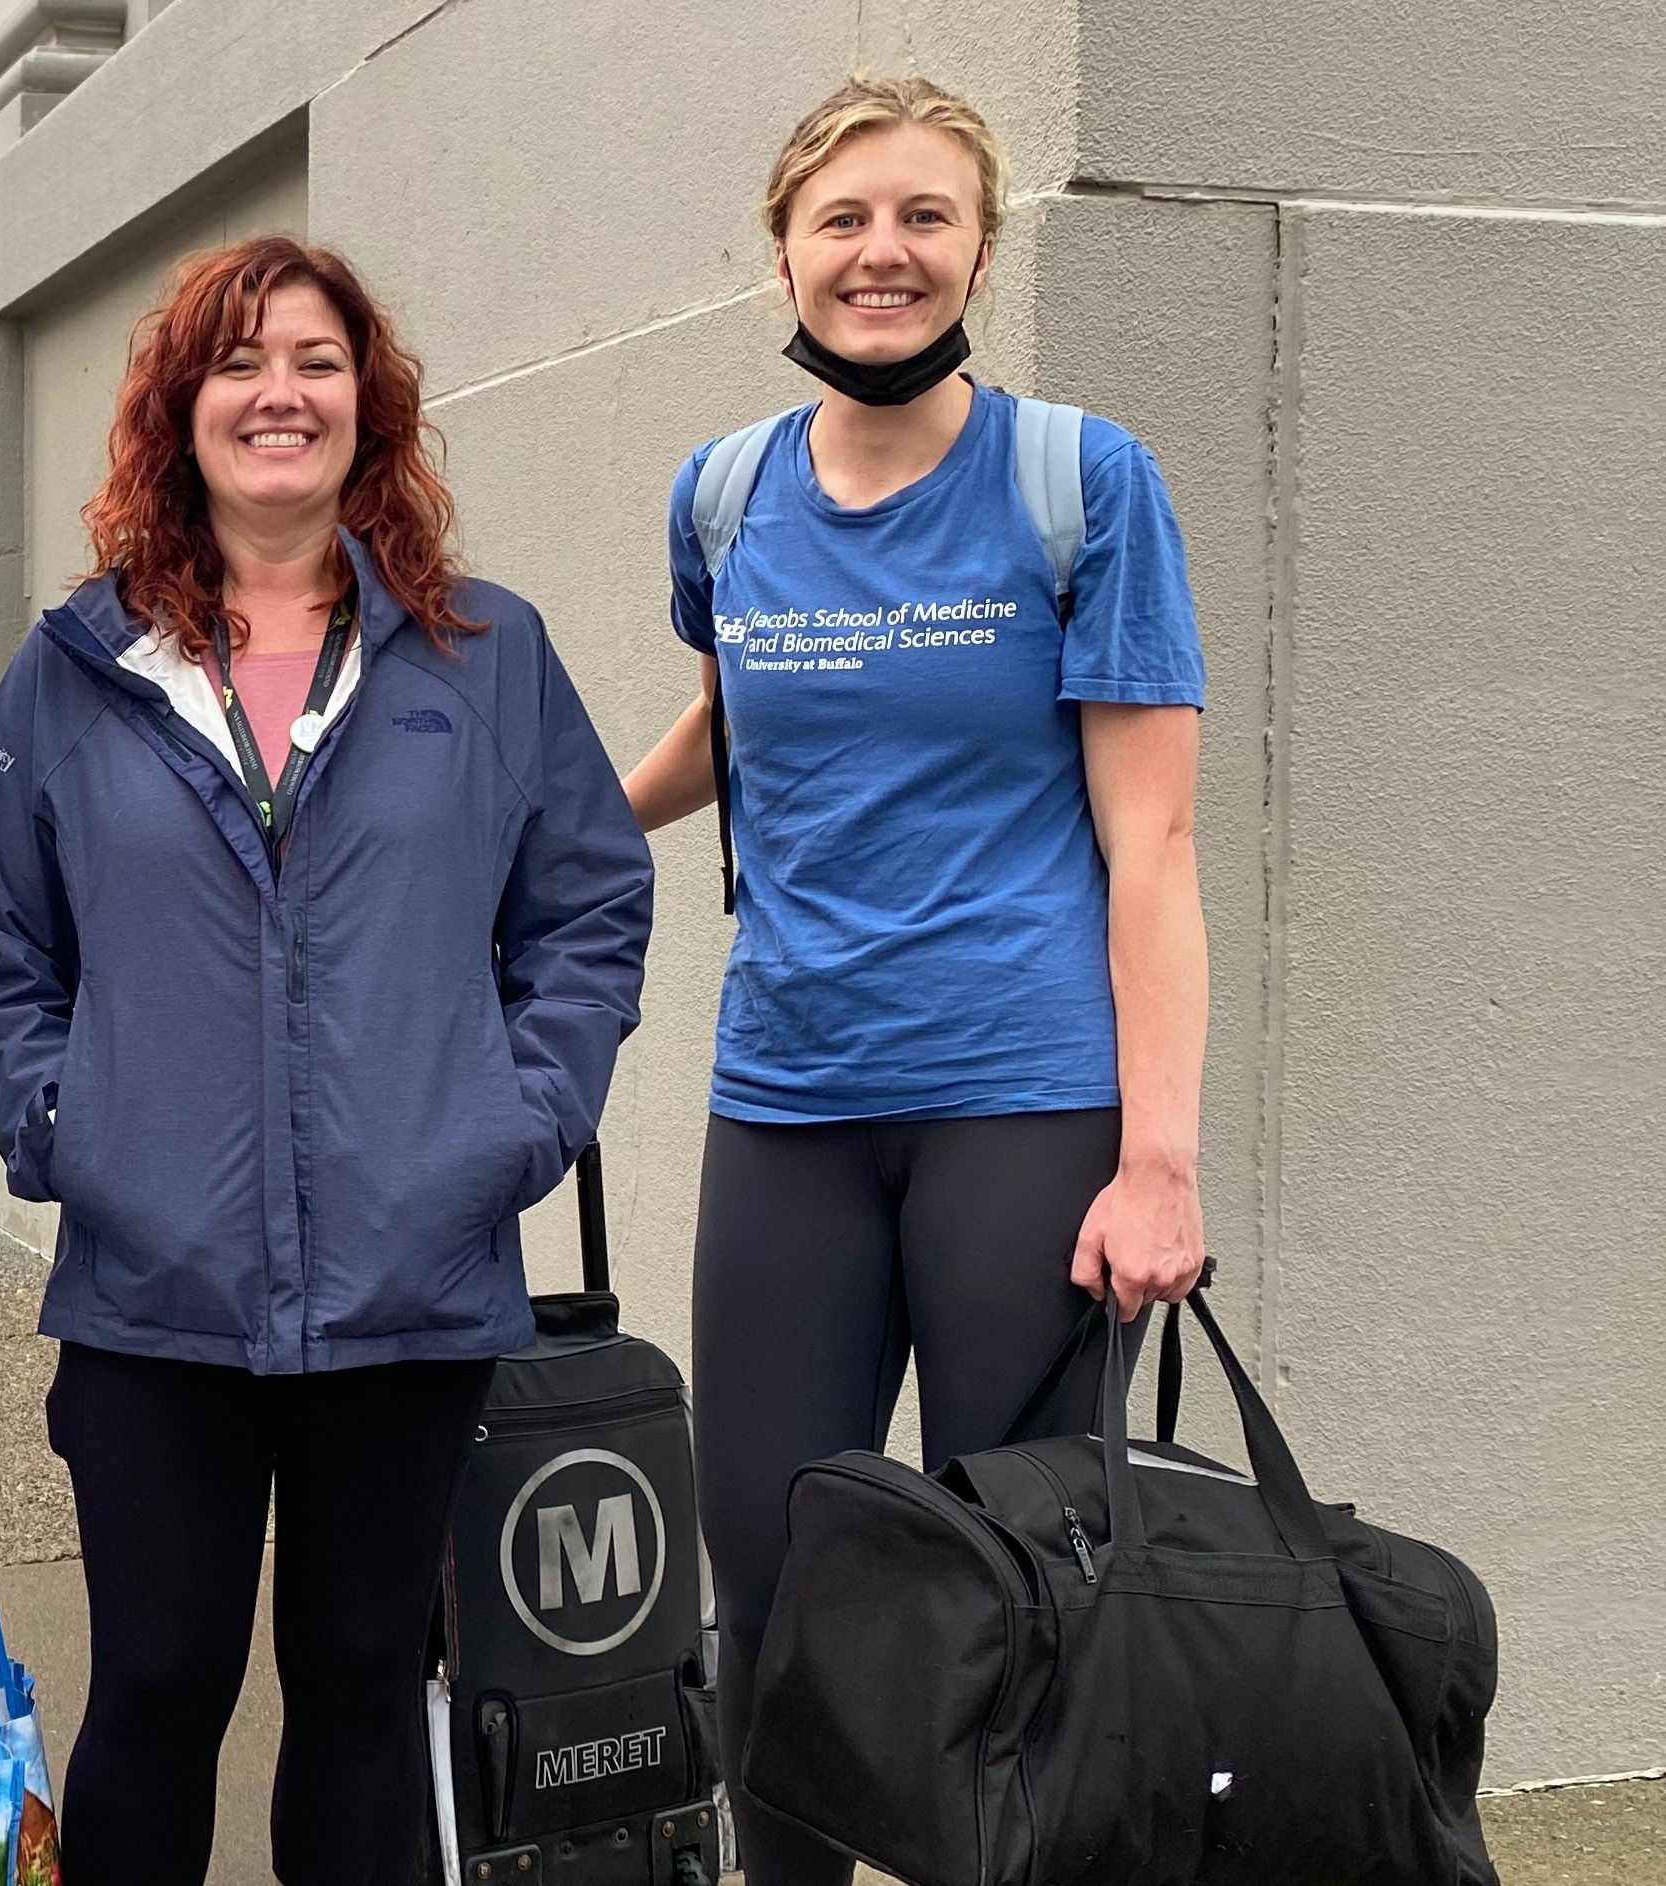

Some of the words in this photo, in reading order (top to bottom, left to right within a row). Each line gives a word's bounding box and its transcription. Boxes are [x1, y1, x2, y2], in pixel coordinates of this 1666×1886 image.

[748, 607, 809, 632] Jacobs
[812, 606, 883, 628] School
[886, 602, 911, 626] of
[913, 598, 1017, 622] Medicine
[748, 632, 779, 653] and
[782, 629, 894, 653] Biomedical
[898, 627, 996, 649] Sciences
[746, 658, 801, 673] University
[802, 659, 815, 670] at
[818, 656, 864, 670] Buffalo
[537, 1493, 642, 1610] M
[535, 1726, 666, 1790] MERET
